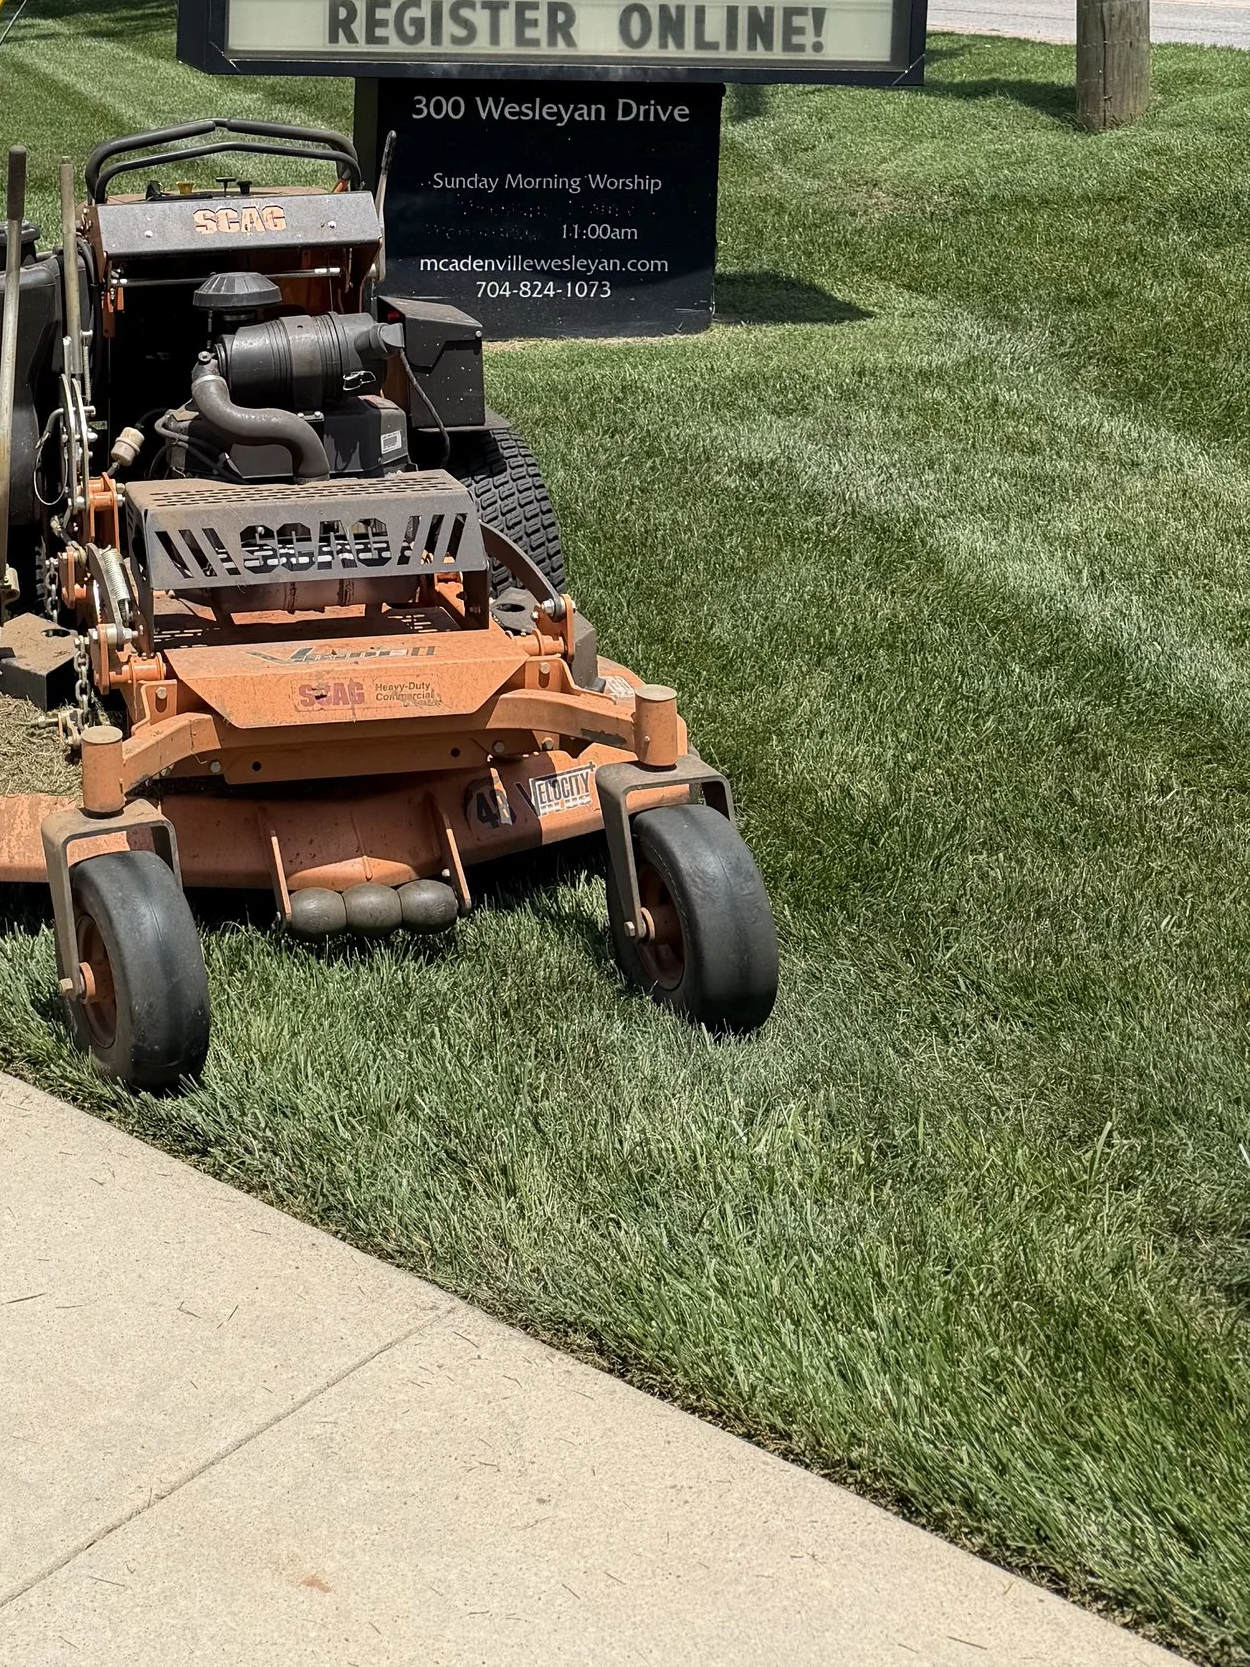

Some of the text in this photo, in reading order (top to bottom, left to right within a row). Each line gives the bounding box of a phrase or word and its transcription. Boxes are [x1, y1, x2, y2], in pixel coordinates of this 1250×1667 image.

[619, 2, 827, 53] ONLINE!
[411, 95, 690, 127] 300 Wesleyan Drive
[432, 172, 662, 195] Sunday Morning Worship
[193, 205, 287, 235] SCAG
[561, 223, 638, 241] 11:00am
[419, 254, 669, 276] mcadenvillewesleyan.com
[476, 280, 612, 299] 704-824-1073
[239, 517, 393, 575] SCAG
[374, 681, 431, 693] Heavy-Duty
